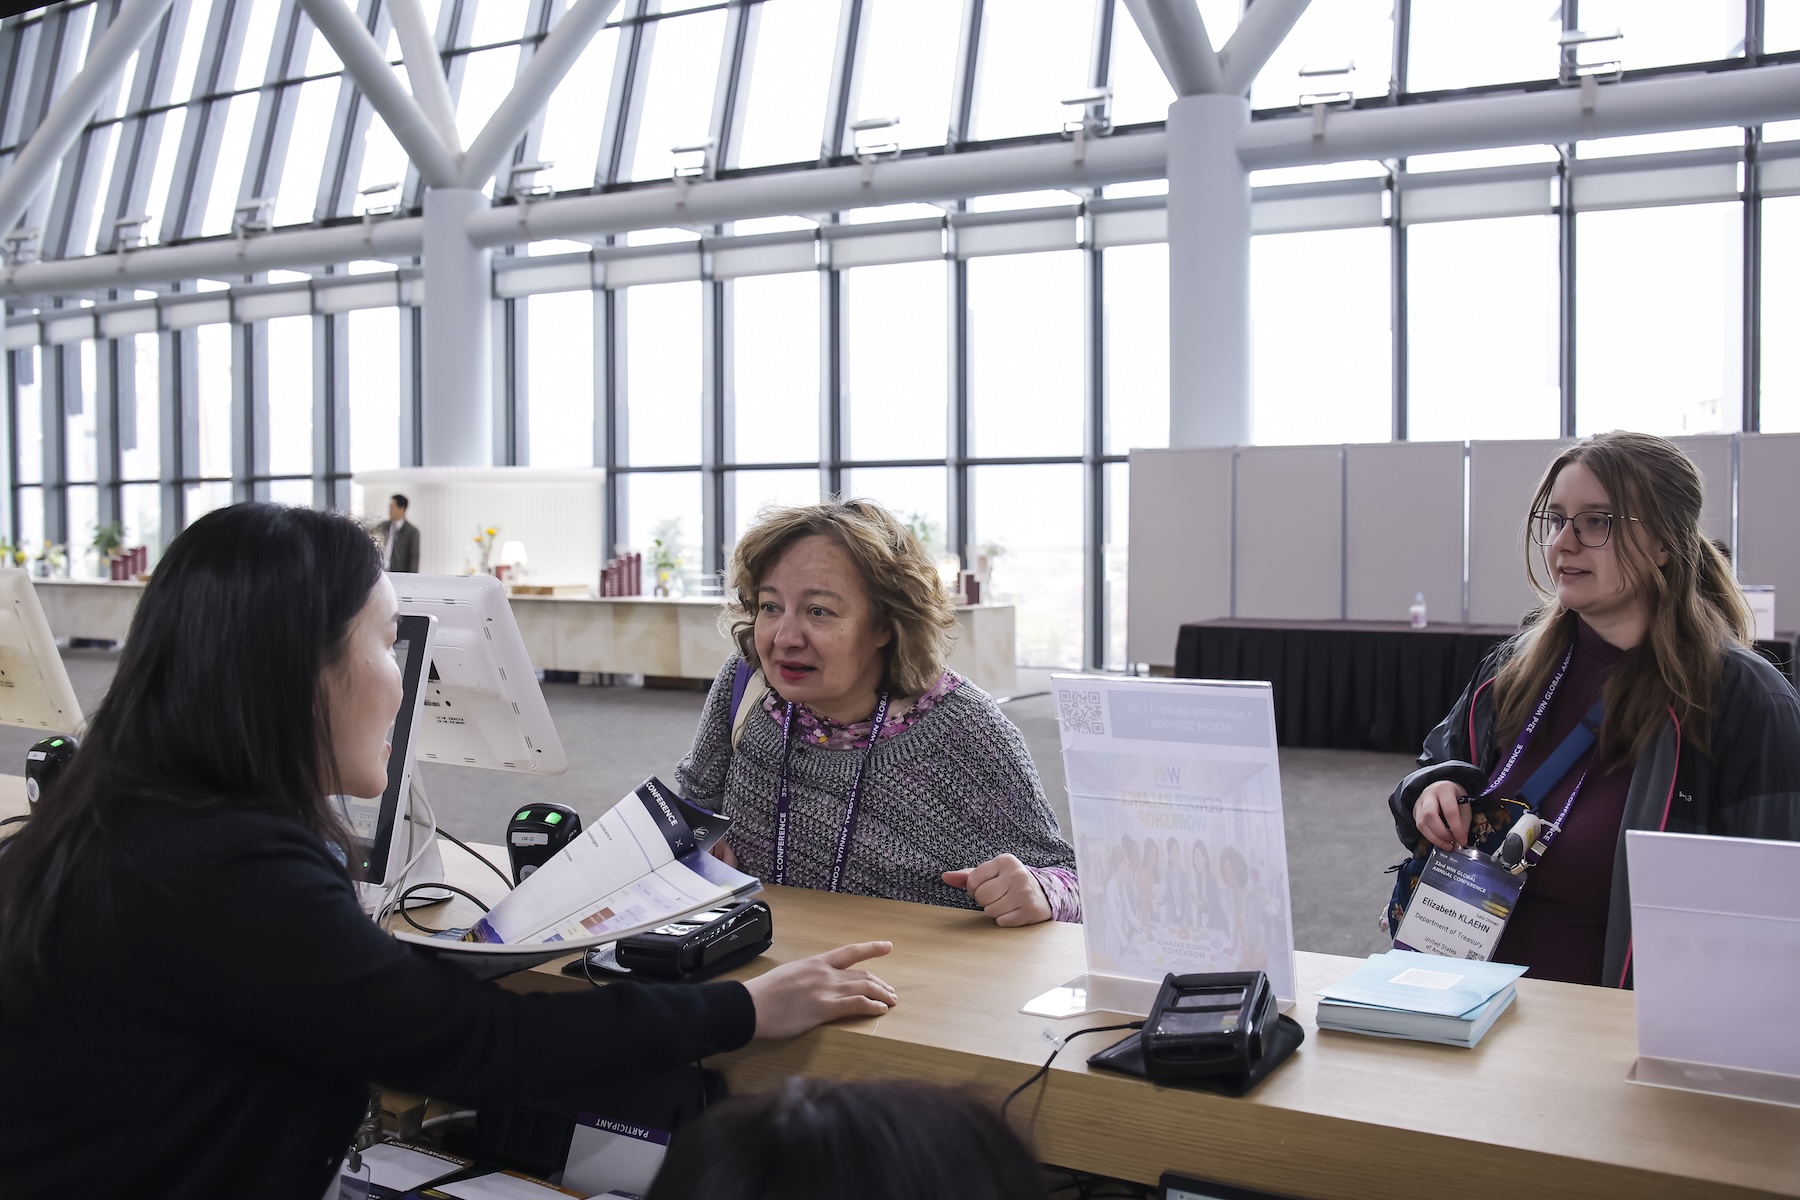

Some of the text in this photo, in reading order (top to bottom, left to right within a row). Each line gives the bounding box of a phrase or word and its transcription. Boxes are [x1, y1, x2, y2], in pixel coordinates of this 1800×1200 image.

[1525, 715, 1539, 734] 33rd
[1544, 672, 1564, 700] GLOBAL
[1490, 743, 1523, 789] CONFERENCE
[645, 781, 679, 827] CONFERENCE
[844, 790, 856, 825] GLOBAL
[776, 812, 787, 871] CONFERENCE
[836, 826, 848, 862] ANNUAL
[1432, 866, 1453, 881] ANNUAL
[1452, 875, 1487, 894] CONFERENCE
[1434, 860, 1446, 870] 33rd
[1456, 868, 1476, 883] GLOBAL
[1414, 911, 1449, 934] Department
[1457, 931, 1484, 948] Treasury
[1422, 896, 1490, 934] Elizabeth KLAEHN
[1424, 936, 1457, 955] United States
[1431, 946, 1453, 958] Ameri
[595, 1117, 650, 1139] PARTICIPANT
